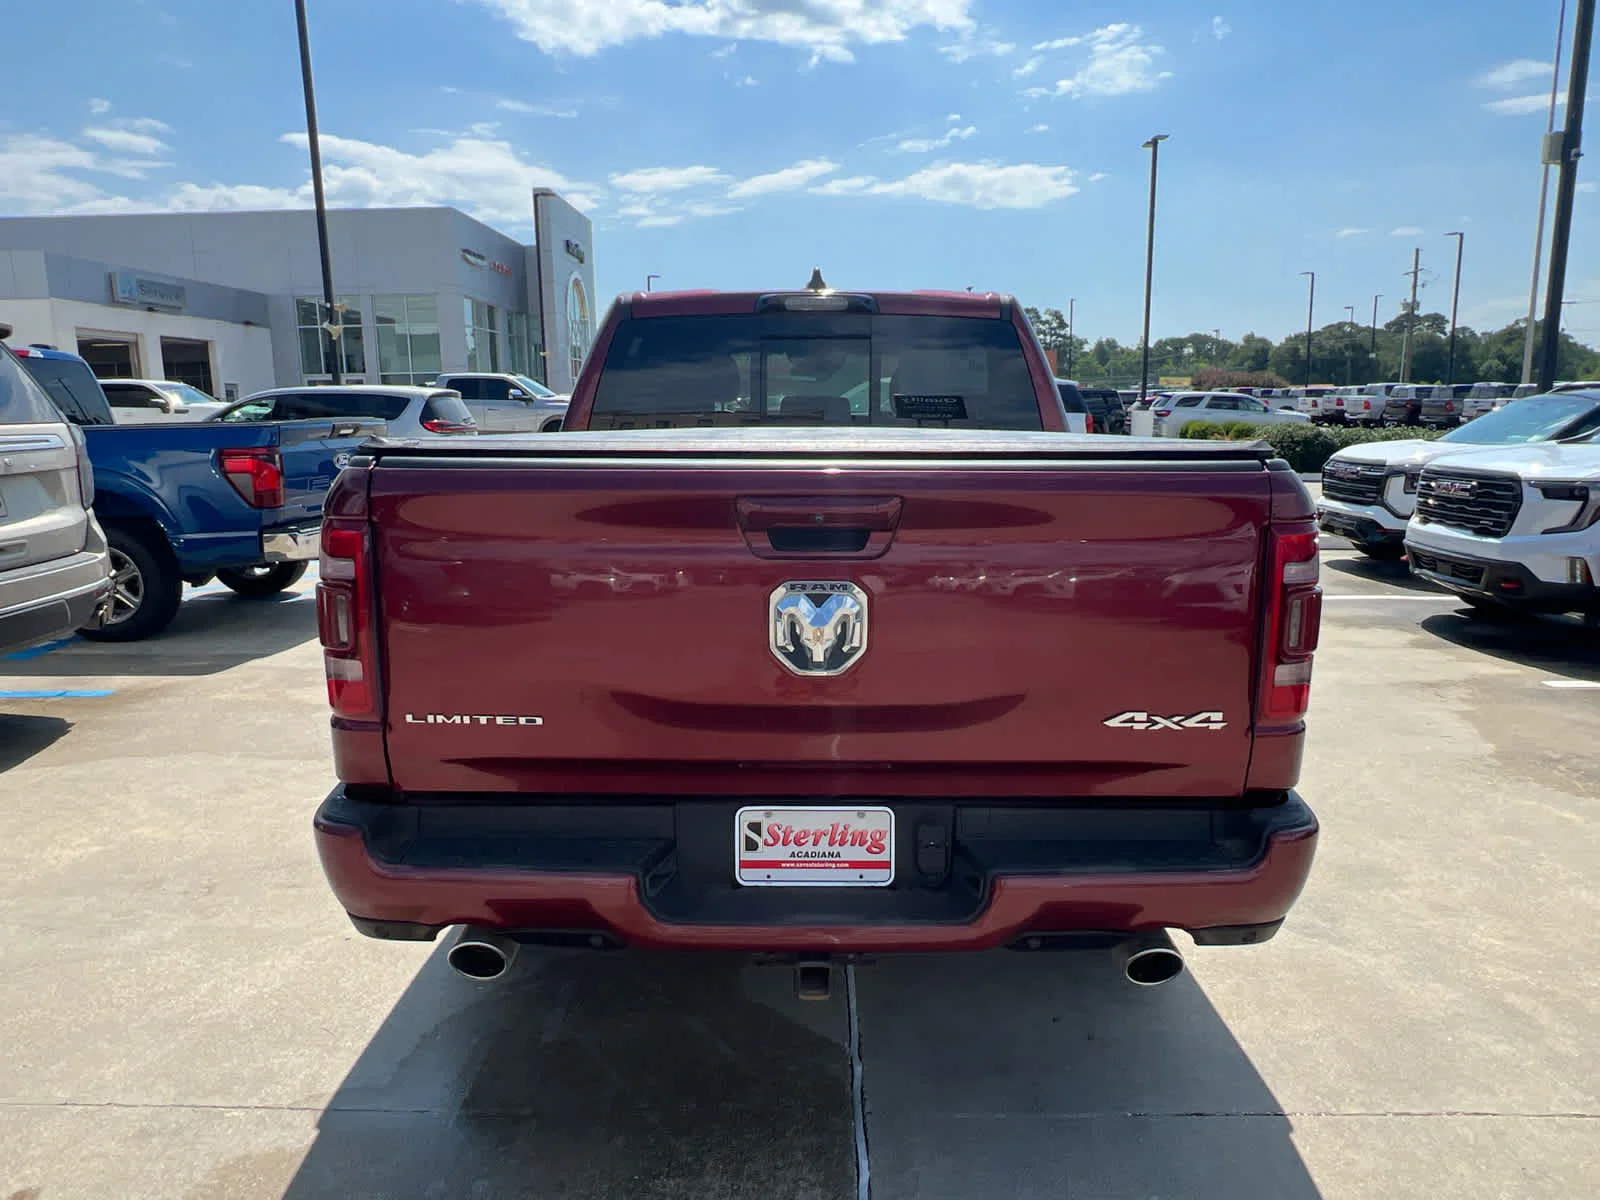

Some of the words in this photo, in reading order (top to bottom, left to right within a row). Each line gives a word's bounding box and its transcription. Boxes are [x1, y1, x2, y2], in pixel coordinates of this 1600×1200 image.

[789, 583, 848, 591] RAM
[404, 713, 544, 726] LIMITED
[1103, 711, 1228, 730] 4x4
[763, 821, 888, 855] Sterling
[789, 850, 842, 859] ACADIANA
